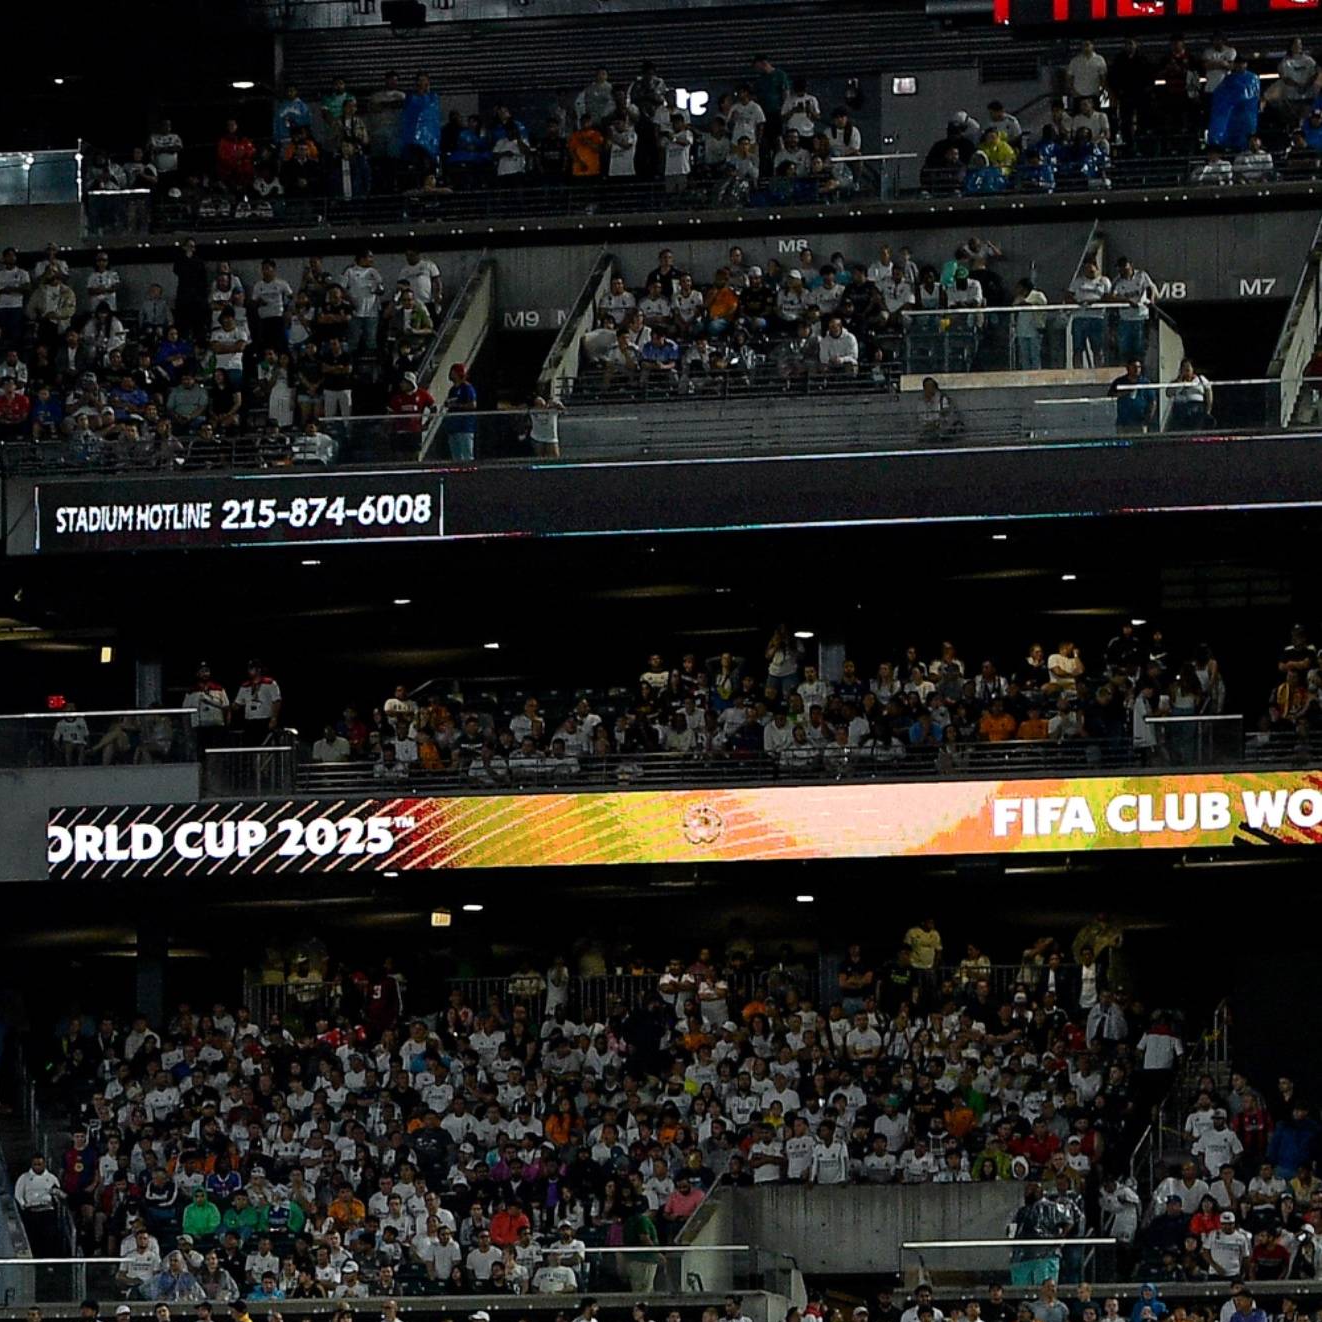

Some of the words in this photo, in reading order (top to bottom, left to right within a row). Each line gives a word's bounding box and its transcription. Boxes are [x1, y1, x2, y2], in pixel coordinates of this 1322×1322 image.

[1239, 278, 1276, 297] M7
[503, 312, 539, 329] M9
[56, 505, 135, 535] STADIUM
[136, 501, 211, 531] HOTLINE
[221, 494, 431, 530] 215-874-6008
[994, 796, 1095, 837] FIFA
[1107, 790, 1230, 833] CLUB
[1241, 788, 1322, 828] WO
[174, 820, 268, 860] CUP
